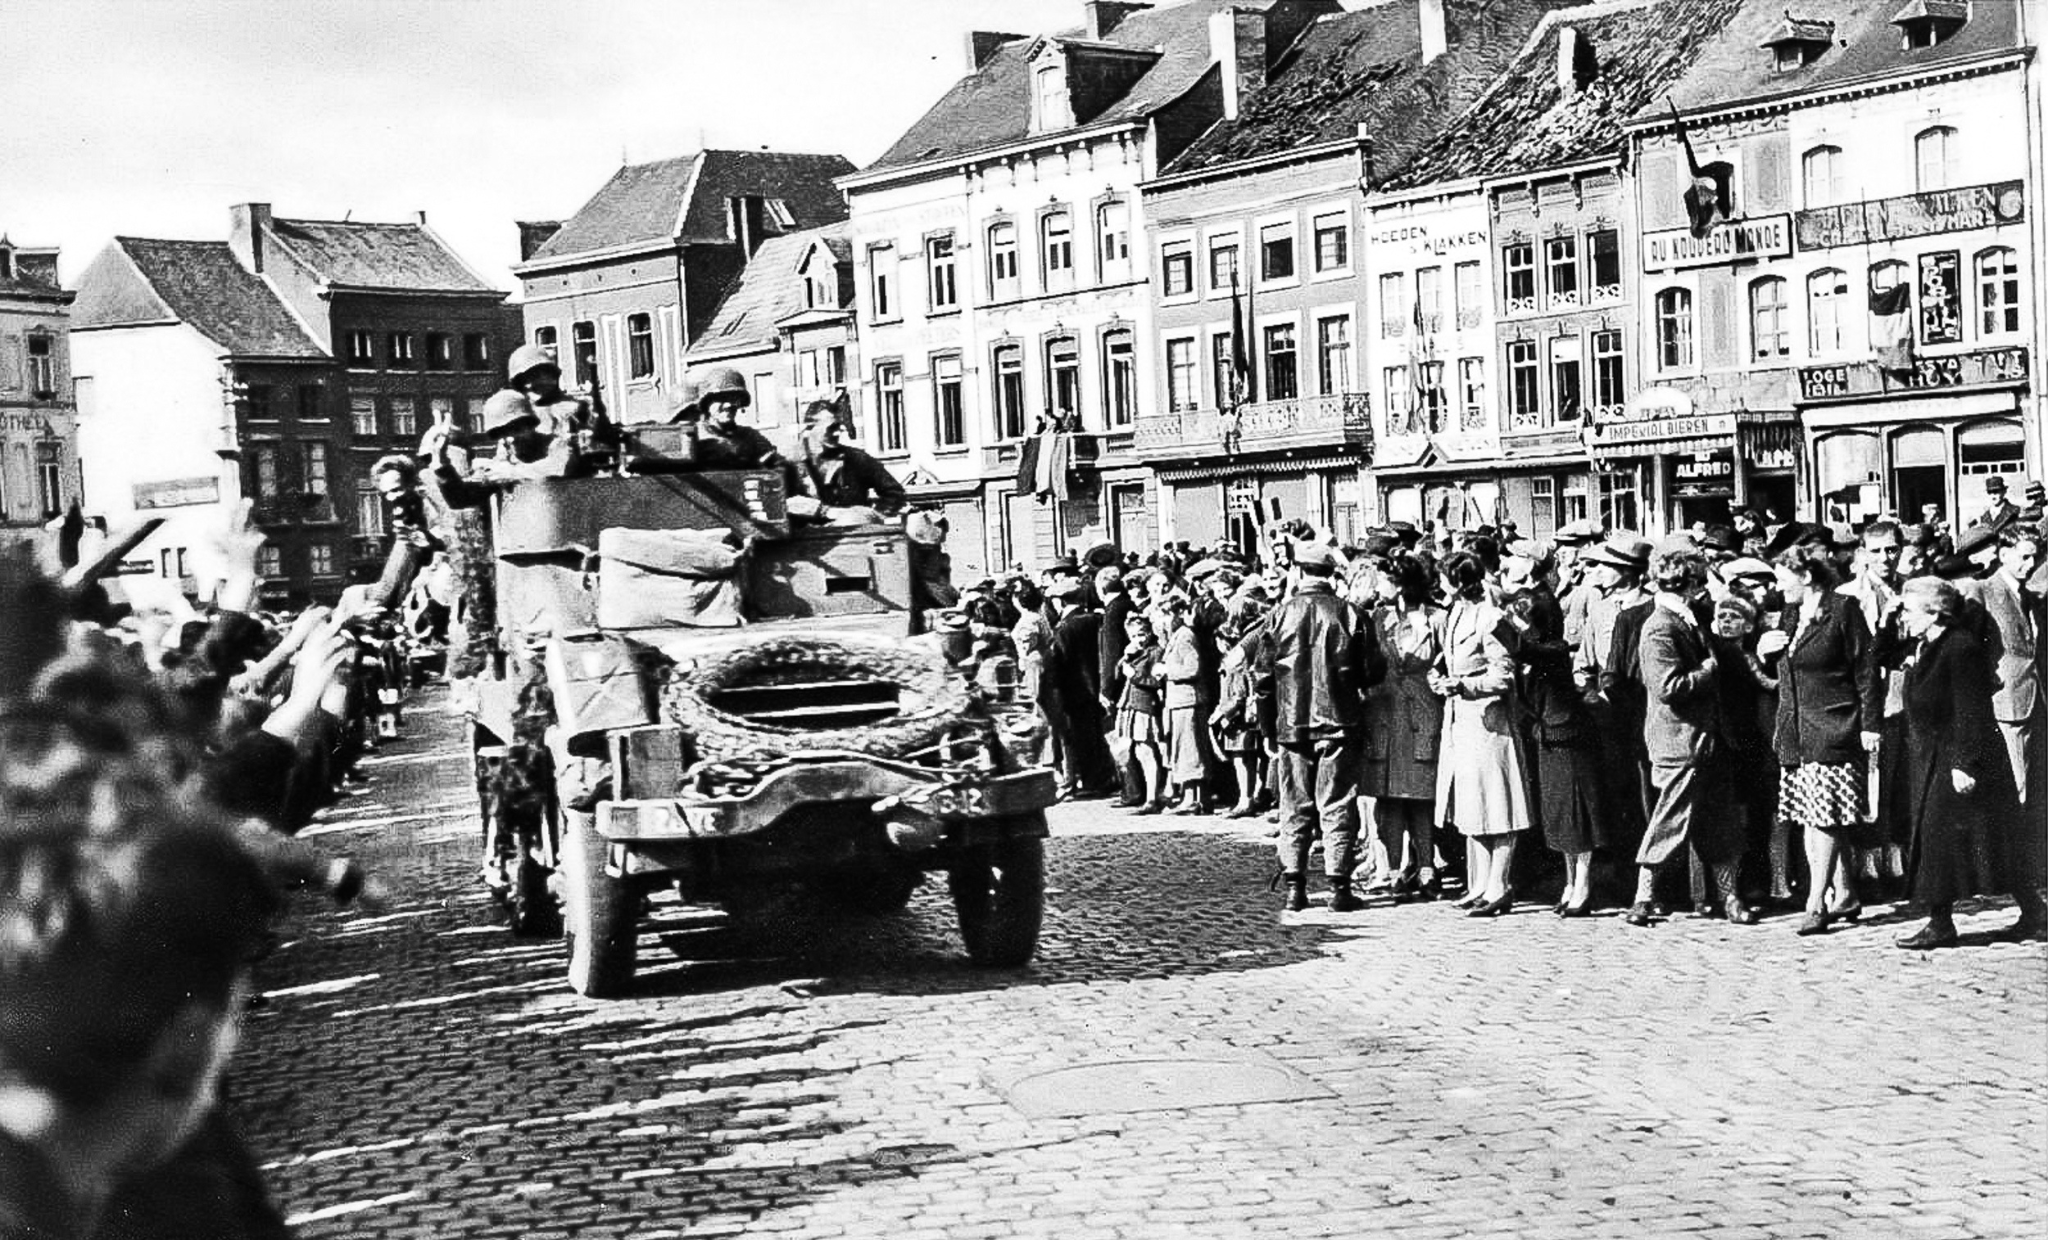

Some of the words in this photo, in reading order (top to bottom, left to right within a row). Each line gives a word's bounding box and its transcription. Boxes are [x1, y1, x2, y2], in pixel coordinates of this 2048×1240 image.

[1371, 226, 1427, 244] HOEDEN
[1424, 231, 1487, 256] KLAKKEN
[1734, 224, 1780, 254] MONDE
[1677, 462, 1731, 478] ALFRED
